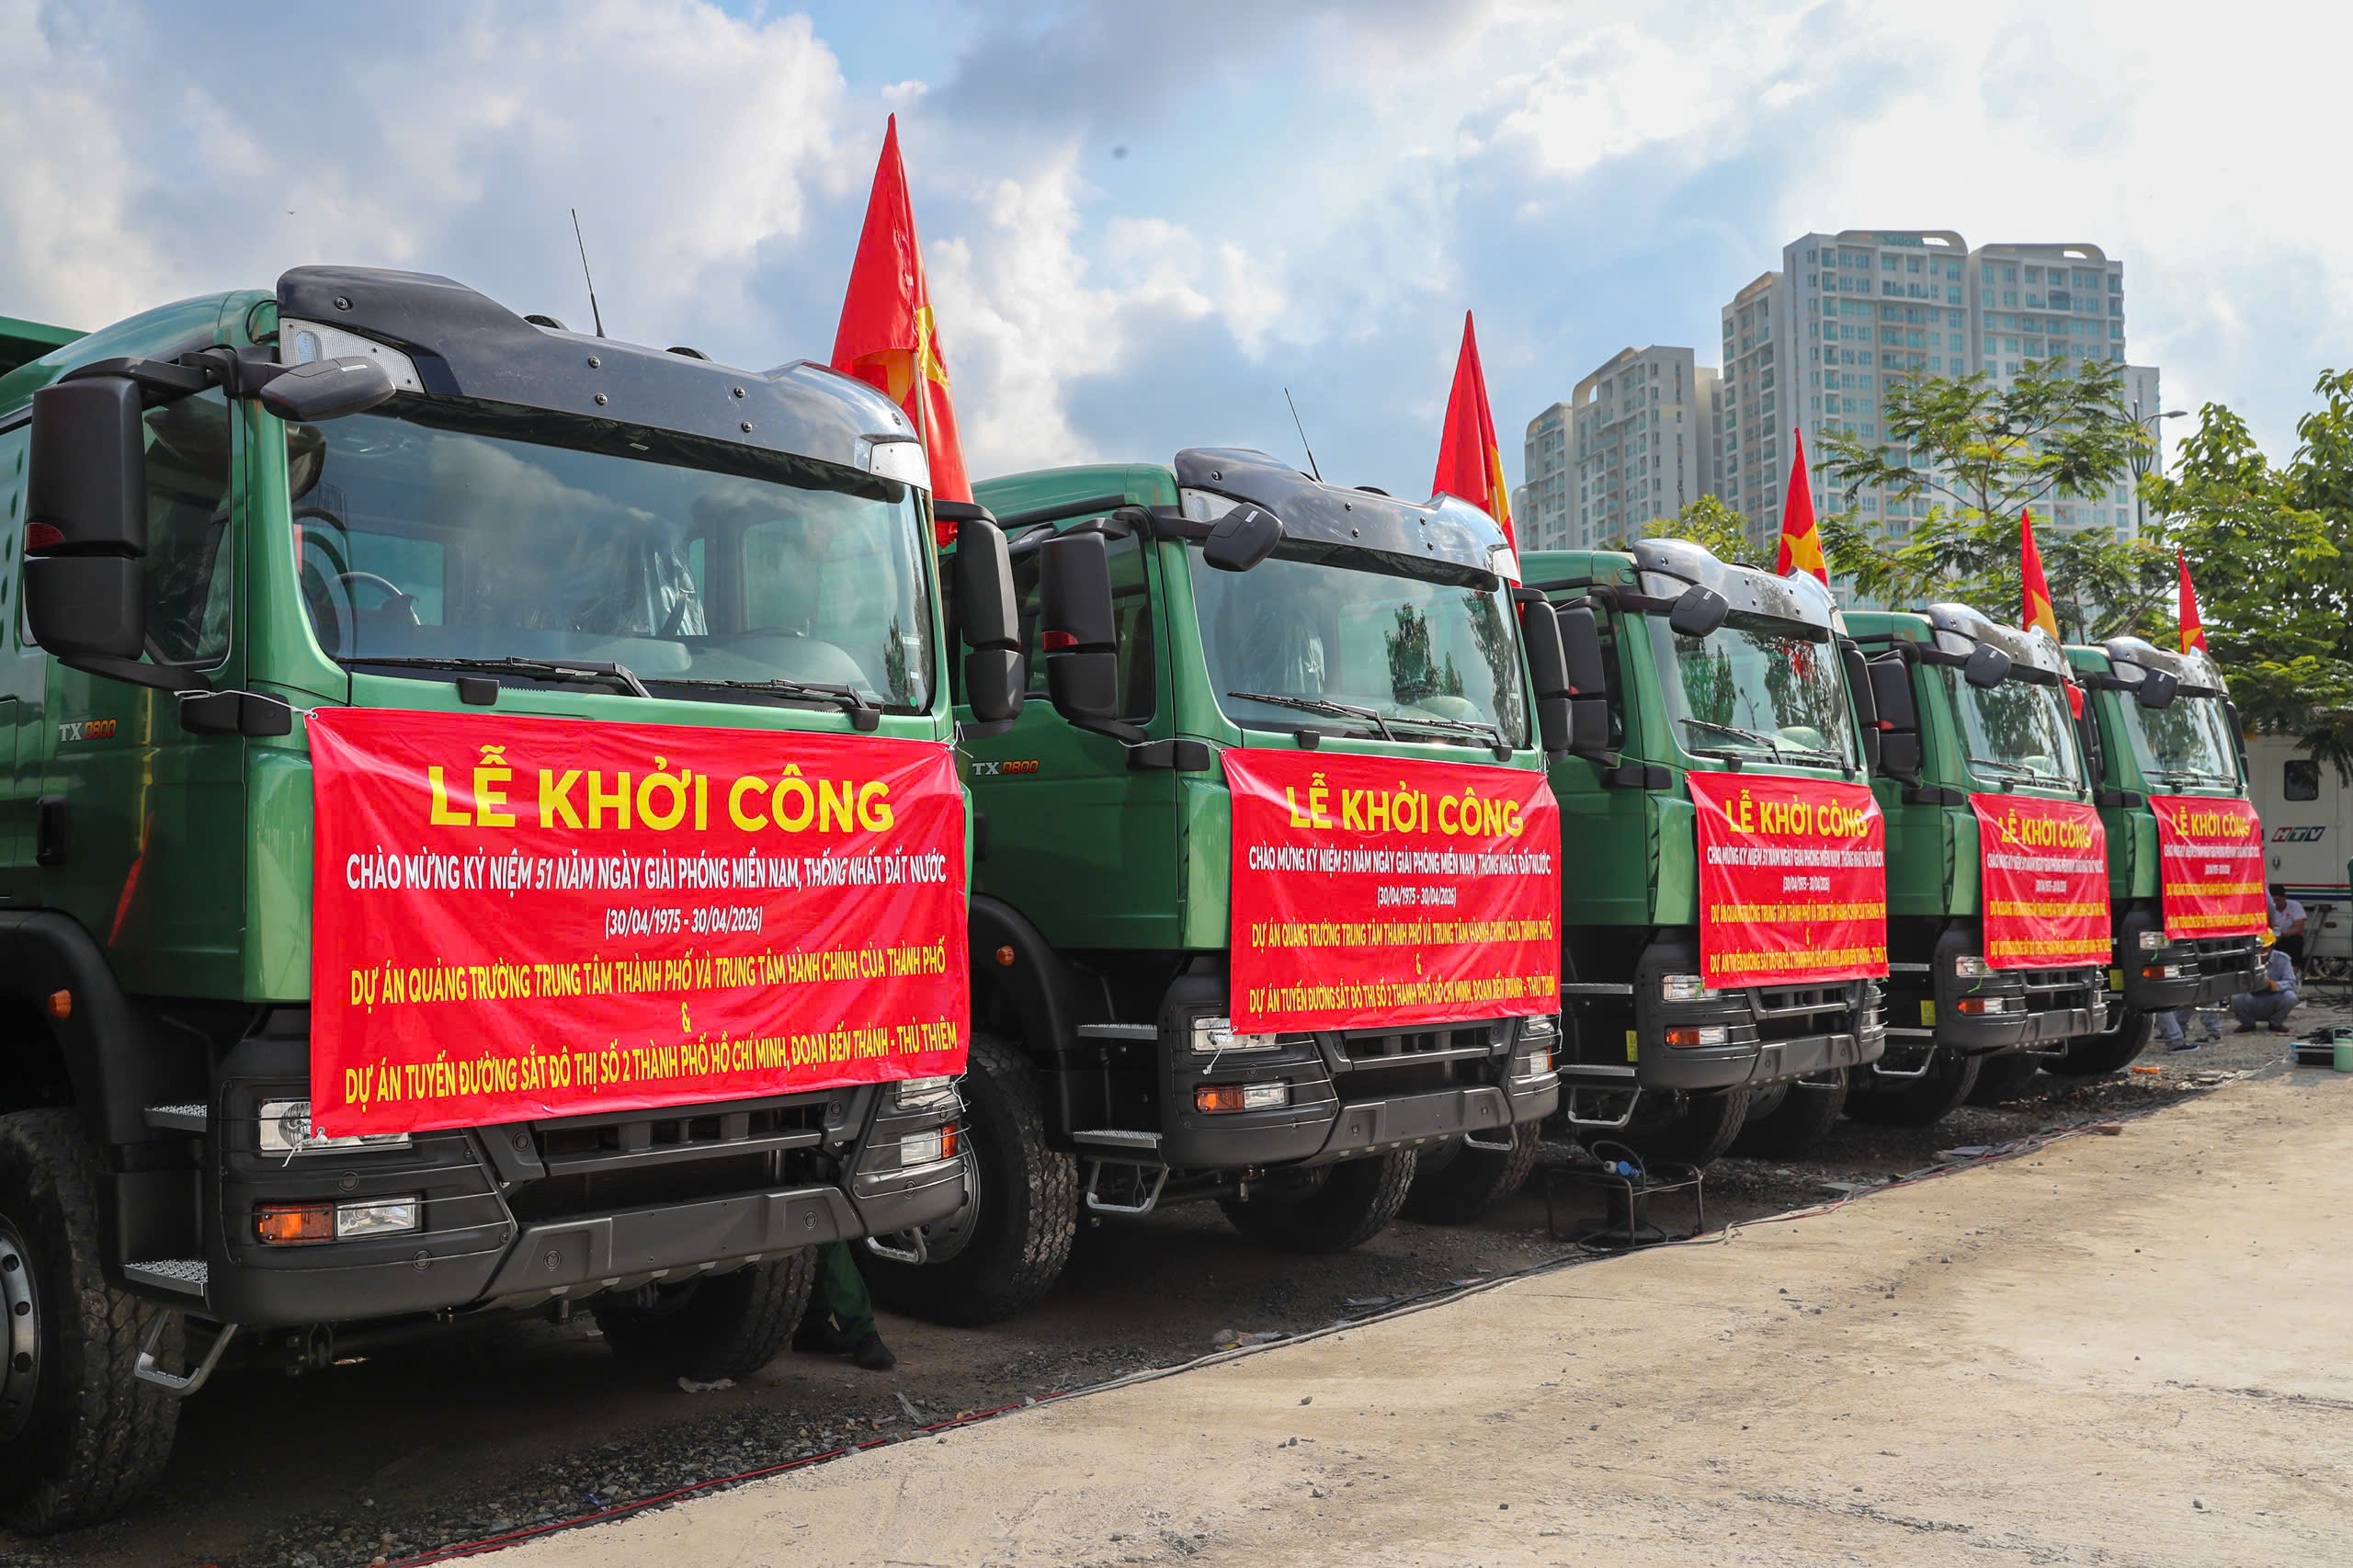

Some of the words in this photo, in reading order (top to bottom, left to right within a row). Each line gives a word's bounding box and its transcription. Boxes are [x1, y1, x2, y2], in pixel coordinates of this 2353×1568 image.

[59, 722, 83, 742] TX
[972, 762, 1000, 776] TX
[428, 745, 516, 827] LỄ
[539, 756, 707, 831] KHỞI
[729, 764, 894, 833] CÔNG
[1286, 772, 1332, 829] LỄ
[1341, 780, 1428, 834] KHỞI
[1438, 787, 1524, 837] CÔNG
[1725, 789, 1755, 833] LỄ
[1759, 794, 1813, 835] KHỞI
[1817, 799, 1868, 837] CÔNG
[1998, 809, 2018, 844] LỄ
[2021, 813, 2057, 846] KHỞI
[2059, 816, 2092, 848] CÔNG
[2172, 806, 2189, 836] LỄ
[2191, 809, 2220, 837] KHỞI
[2222, 811, 2251, 837] CÔNG
[2271, 826, 2326, 842] HTV
[347, 845, 402, 890] CHÀO
[404, 846, 460, 890] MỪNG
[463, 846, 486, 889] KỶ
[490, 847, 533, 898] NIỆM
[535, 858, 552, 890] 51
[555, 848, 594, 889] NĂM
[597, 848, 641, 890] NGÀY
[645, 848, 675, 889] GIẢI
[677, 849, 729, 889] PHÓNG
[733, 846, 766, 888] MIỀN
[769, 858, 802, 892] NAM,
[804, 847, 848, 887] THỐNG
[848, 846, 881, 885] NHẤT
[885, 845, 907, 884] ĐẤT
[910, 847, 947, 883] NƯỚC
[1249, 840, 1275, 870] CHÀO
[1278, 841, 1305, 871] MỪNG
[1306, 841, 1317, 871] KỶ
[1320, 843, 1341, 879] NIỆM
[1343, 849, 1351, 872] 51
[1353, 844, 1371, 872] NĂM
[1372, 845, 1394, 873] NGÀY
[1396, 846, 1412, 874] GIẢI
[1413, 846, 1439, 874] PHÓNG
[1440, 845, 1458, 874] MIỀN
[1459, 853, 1476, 879] NAM,
[1377, 884, 1415, 908] (30/04/1975
[1420, 885, 1456, 908] 30/04/2026)
[606, 905, 681, 940] (30/04/1975
[691, 904, 763, 936] 30/04/2026)
[1252, 921, 1267, 954] DỰ
[1268, 916, 1280, 948] ÁN
[1281, 916, 1308, 948] QUẢNG
[1309, 917, 1340, 947] TRƯỜNG
[1342, 923, 1366, 946] TRUNG
[1367, 917, 1382, 946] TÂM
[1383, 916, 1407, 945] THÀNH
[1408, 915, 1422, 945] PHỐ
[1423, 916, 1432, 945] VÀ
[1433, 922, 1454, 945] TRUNG
[1454, 916, 1470, 944] TÂM
[351, 967, 379, 1014] DỰ
[381, 960, 404, 1005] ÁN
[408, 957, 467, 1003] QUẢNG
[469, 957, 530, 1000] TRƯỜNG
[534, 963, 581, 997] TRUNG
[584, 954, 612, 995] TÂM
[616, 952, 662, 994] THÀNH
[665, 948, 694, 991] PHỐ
[696, 950, 712, 989] VÀ
[715, 956, 756, 988] TRUNG
[758, 948, 786, 985] TÂM
[787, 946, 821, 983] HÀNH
[823, 943, 858, 982] CHÍNH
[859, 941, 886, 979] CỦA
[887, 940, 920, 977] THÀNH
[923, 935, 946, 974] PHỐ
[1250, 987, 1265, 1019] DỰ
[1267, 983, 1279, 1013] ÁN
[1280, 979, 1307, 1012] TUYẾN
[1308, 981, 1335, 1010] ĐƯỜNG
[1336, 978, 1349, 1009] SẮT
[1350, 979, 1362, 1009] ĐÔ
[1362, 985, 1377, 1013] THỊ
[1376, 976, 1386, 1007] SỐ
[1387, 984, 1392, 1006] 2
[1392, 978, 1416, 1006] THÀNH
[1416, 974, 1432, 1005] PHỐ
[681, 1001, 691, 1033] &
[346, 1064, 373, 1113] DỰ
[377, 1057, 401, 1102] ÁN
[405, 1050, 456, 1099] TUYẾN
[459, 1051, 517, 1095] ĐƯỜNG
[520, 1044, 546, 1090] SẮT
[549, 1045, 571, 1087] ĐÔ
[574, 1051, 597, 1093] THỊ
[600, 1039, 620, 1084] SỐ
[622, 1051, 630, 1082] 2
[632, 1039, 678, 1081] THÀNH
[681, 1031, 709, 1076] PHỐ
[710, 1030, 730, 1074] HỒ
[733, 1031, 754, 1072] CHÍ
[756, 1037, 790, 1072] MINH,
[791, 1033, 826, 1072] ĐOẠN
[829, 1020, 851, 1062] BẾN
[853, 1022, 889, 1060] THÀNH
[896, 1017, 920, 1054] THỦ
[921, 1015, 958, 1052] THIÊM
